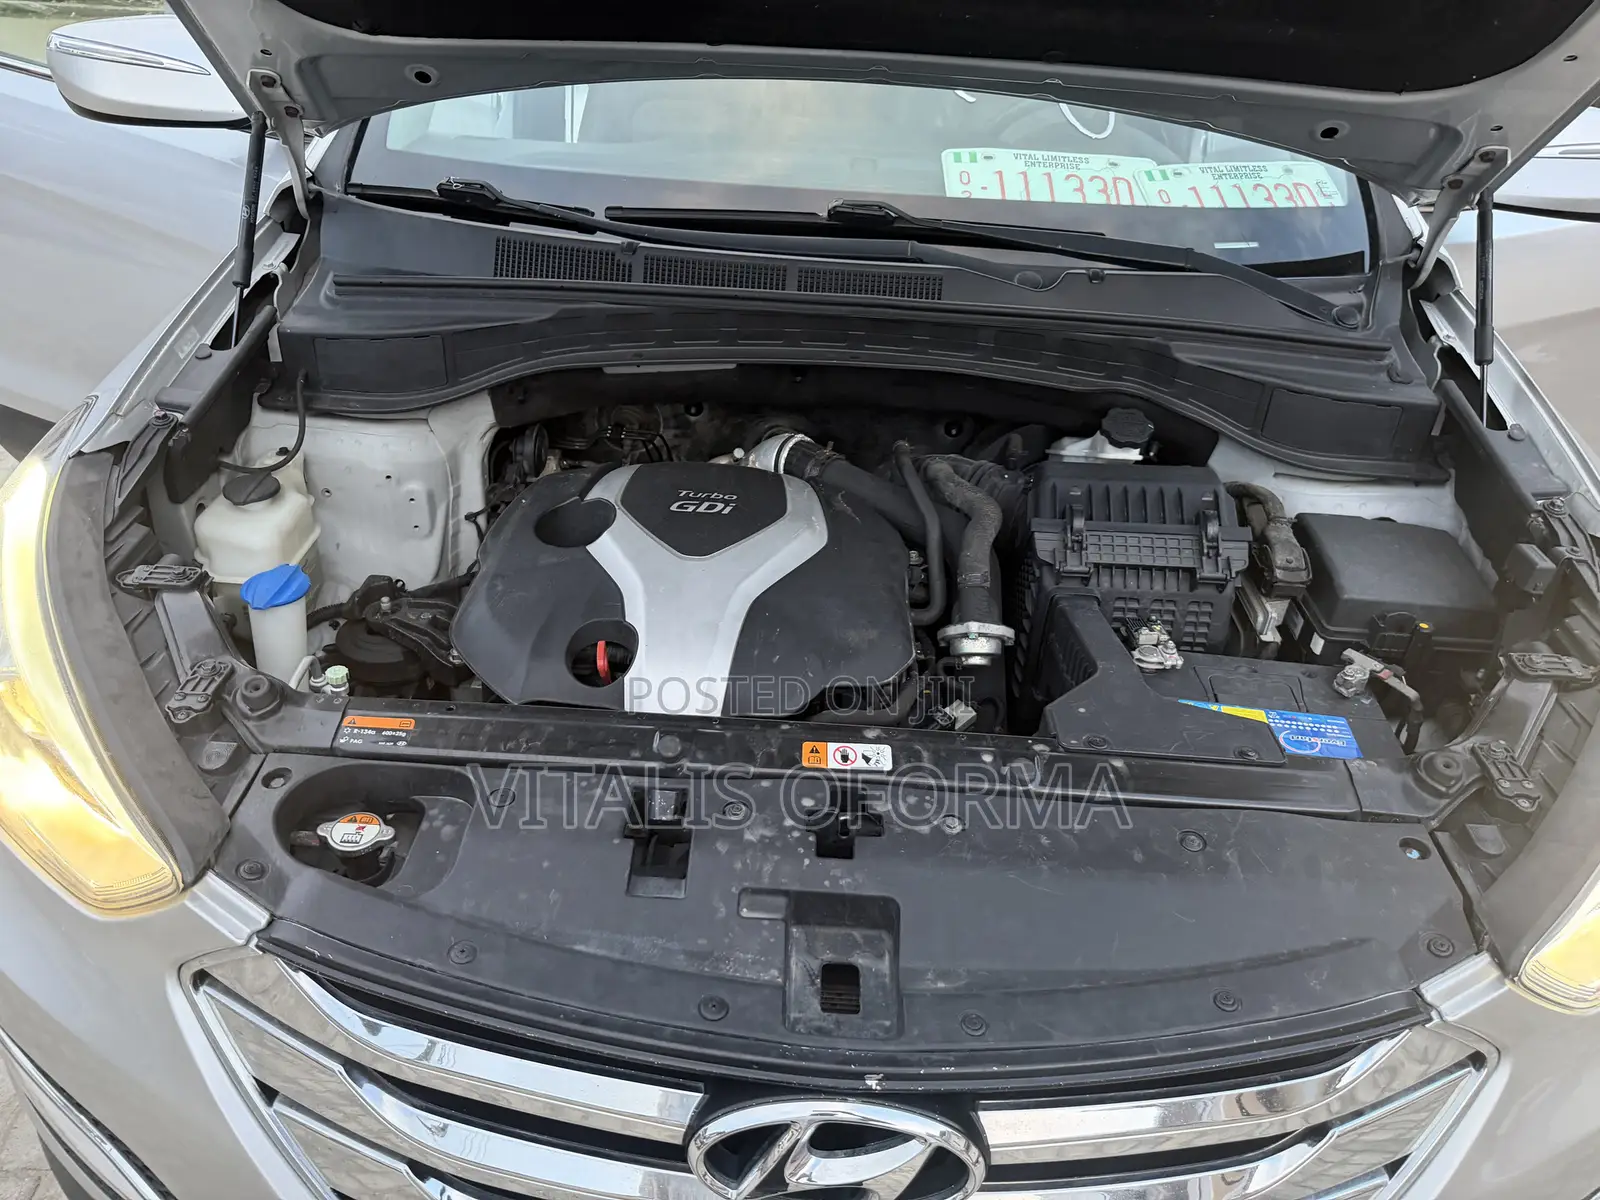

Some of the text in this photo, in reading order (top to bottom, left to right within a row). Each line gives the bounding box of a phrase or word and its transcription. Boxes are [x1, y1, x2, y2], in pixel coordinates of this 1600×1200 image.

[1013, 152, 1090, 164] VITAL LIMITLESS
[1024, 160, 1081, 170] ENTERPRISE
[1199, 165, 1268, 173] VITAL LIMITLESS
[1211, 172, 1263, 180] ENTERPRISE
[678, 489, 738, 500] Turbo
[670, 500, 736, 514] GDi
